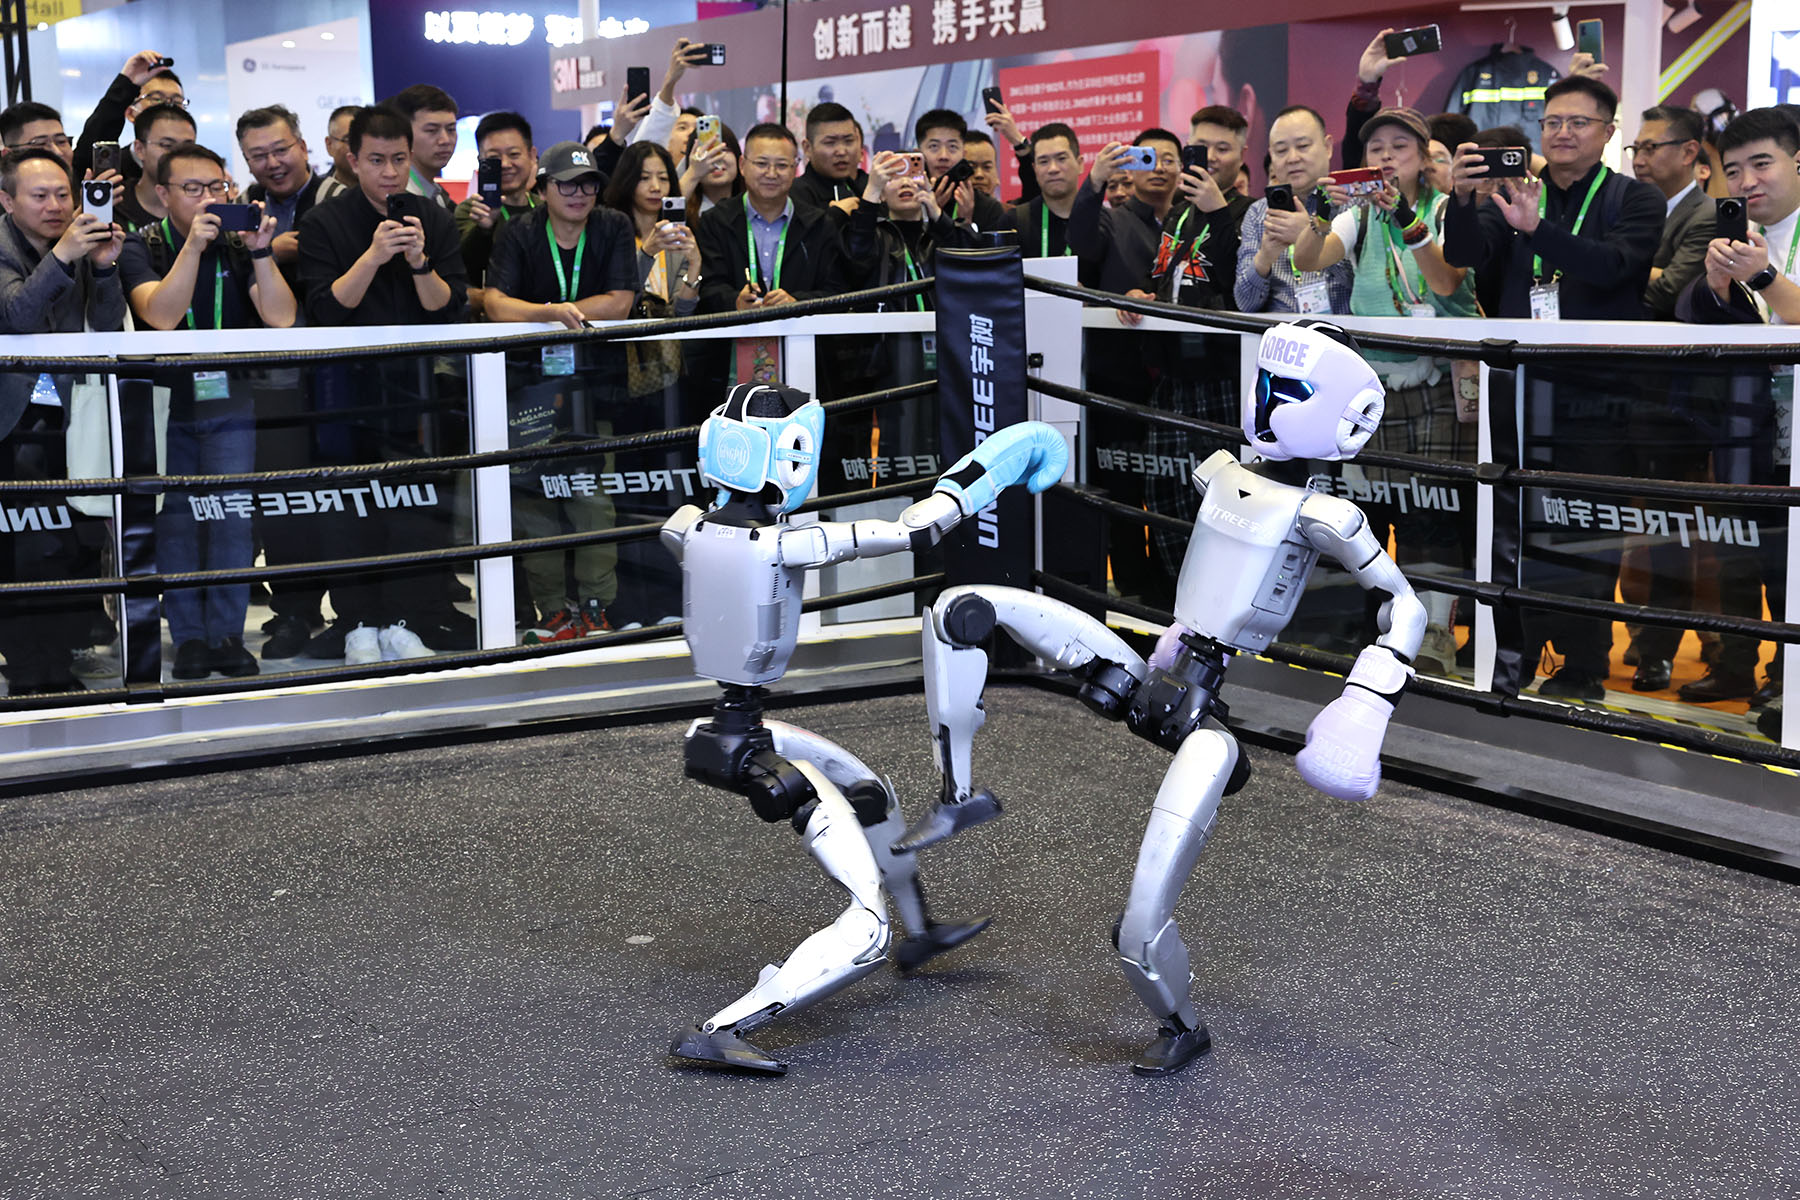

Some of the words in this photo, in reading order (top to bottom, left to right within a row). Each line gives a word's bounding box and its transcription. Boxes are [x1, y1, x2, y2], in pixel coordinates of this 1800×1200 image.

[813, 5, 912, 60] 创新而越
[932, 0, 1046, 45] 携手共赢
[554, 57, 578, 92] 3M
[1261, 334, 1310, 367] FORCE
[973, 377, 999, 549] UNEE
